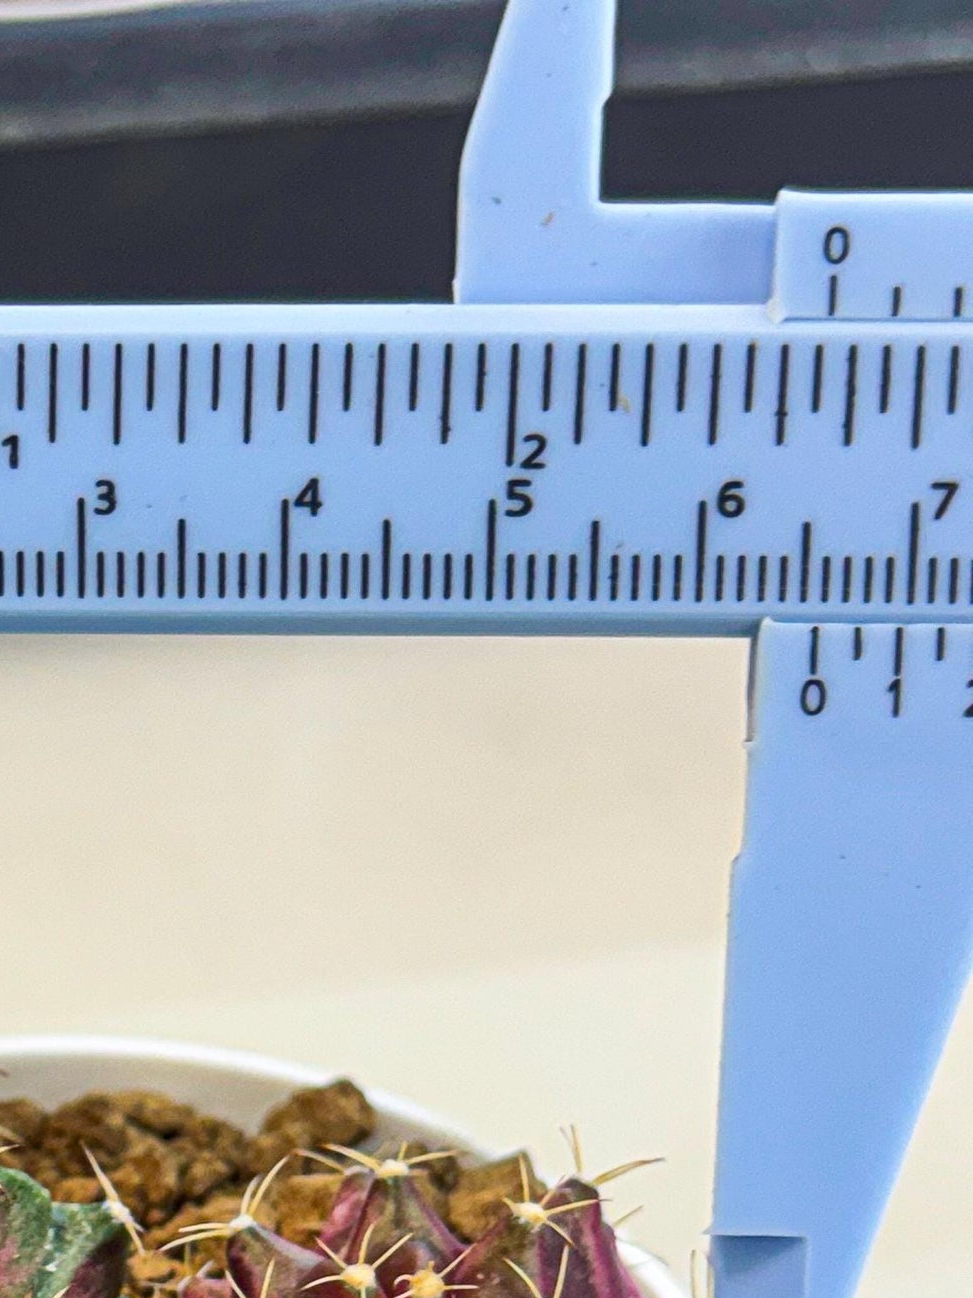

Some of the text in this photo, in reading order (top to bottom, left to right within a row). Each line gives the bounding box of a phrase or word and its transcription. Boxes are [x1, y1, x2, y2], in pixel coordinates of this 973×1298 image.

[822, 226, 850, 265] 0
[1, 434, 20, 470] 1
[519, 433, 547, 470] 2
[93, 479, 117, 516] 3
[292, 477, 323, 517] 4
[504, 478, 533, 518] 5
[716, 480, 745, 519] 6
[930, 481, 959, 521] 7
[799, 678, 903, 718] 0 1
